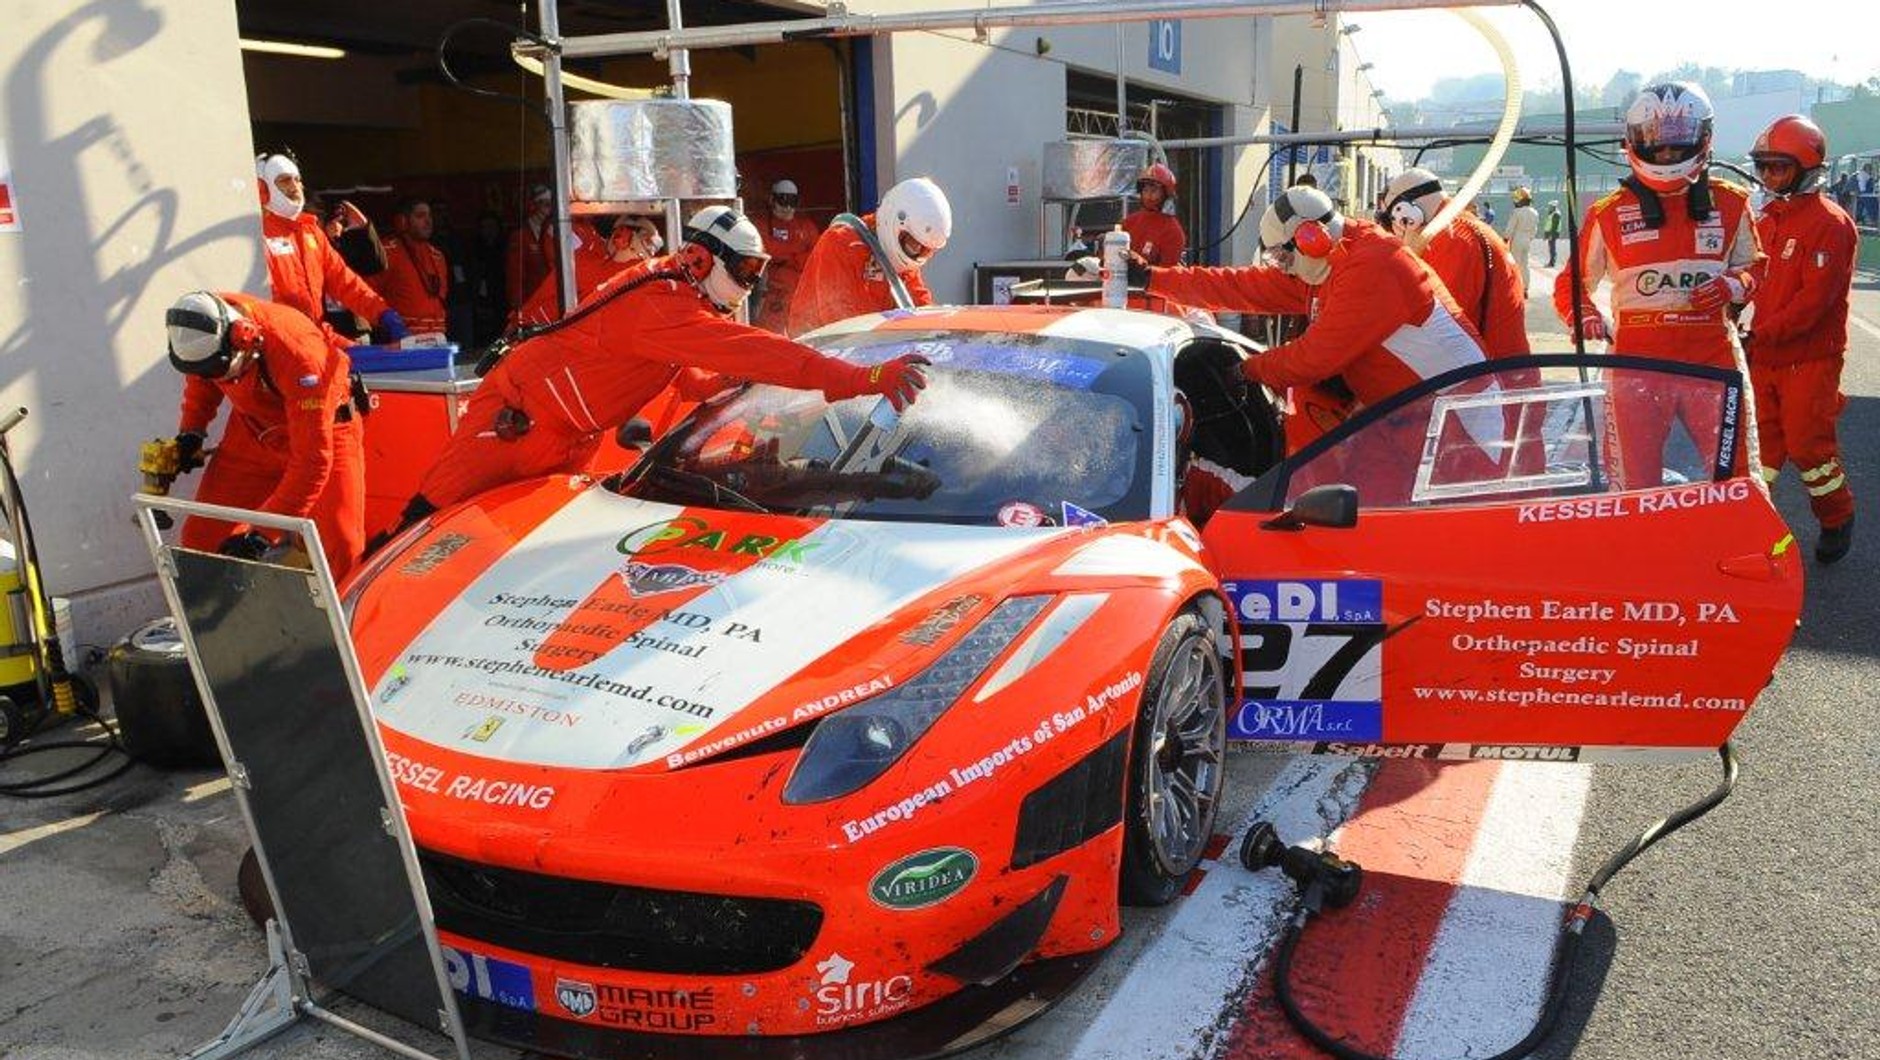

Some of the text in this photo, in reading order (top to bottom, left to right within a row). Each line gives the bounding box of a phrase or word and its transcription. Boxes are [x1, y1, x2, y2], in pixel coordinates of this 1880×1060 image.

[1718, 386, 1739, 468] KESSEL RACING
[1518, 482, 1750, 523] KESSEL RACING
[487, 592, 763, 643] Stephen Earle MD, PA
[1425, 598, 1740, 627] Stephen Earle MD, PA
[484, 614, 707, 659] Orthopaedic Spinal
[512, 638, 603, 664] Surgery
[1452, 633, 1698, 660] Orthopaedic Spinal
[406, 653, 714, 719] www.stephenearlemd.com
[1519, 662, 1617, 684] Surgery
[453, 690, 582, 728] EDMISTON
[1413, 685, 1745, 711] www.stephenearlemd.com
[1237, 702, 1324, 735] ORMA
[665, 715, 788, 770] Benvenuto
[1327, 743, 1431, 758] Sabelt
[1474, 746, 1575, 760] MOTUL
[385, 751, 555, 809] ESSEL RACING
[841, 776, 952, 844] European
[949, 735, 1034, 788] Imports
[1033, 719, 1055, 745] of
[1052, 705, 1086, 734] San
[880, 868, 965, 898] VIRIDEA
[596, 985, 715, 1011] MAMÉ
[600, 1006, 716, 1031] GROUP
